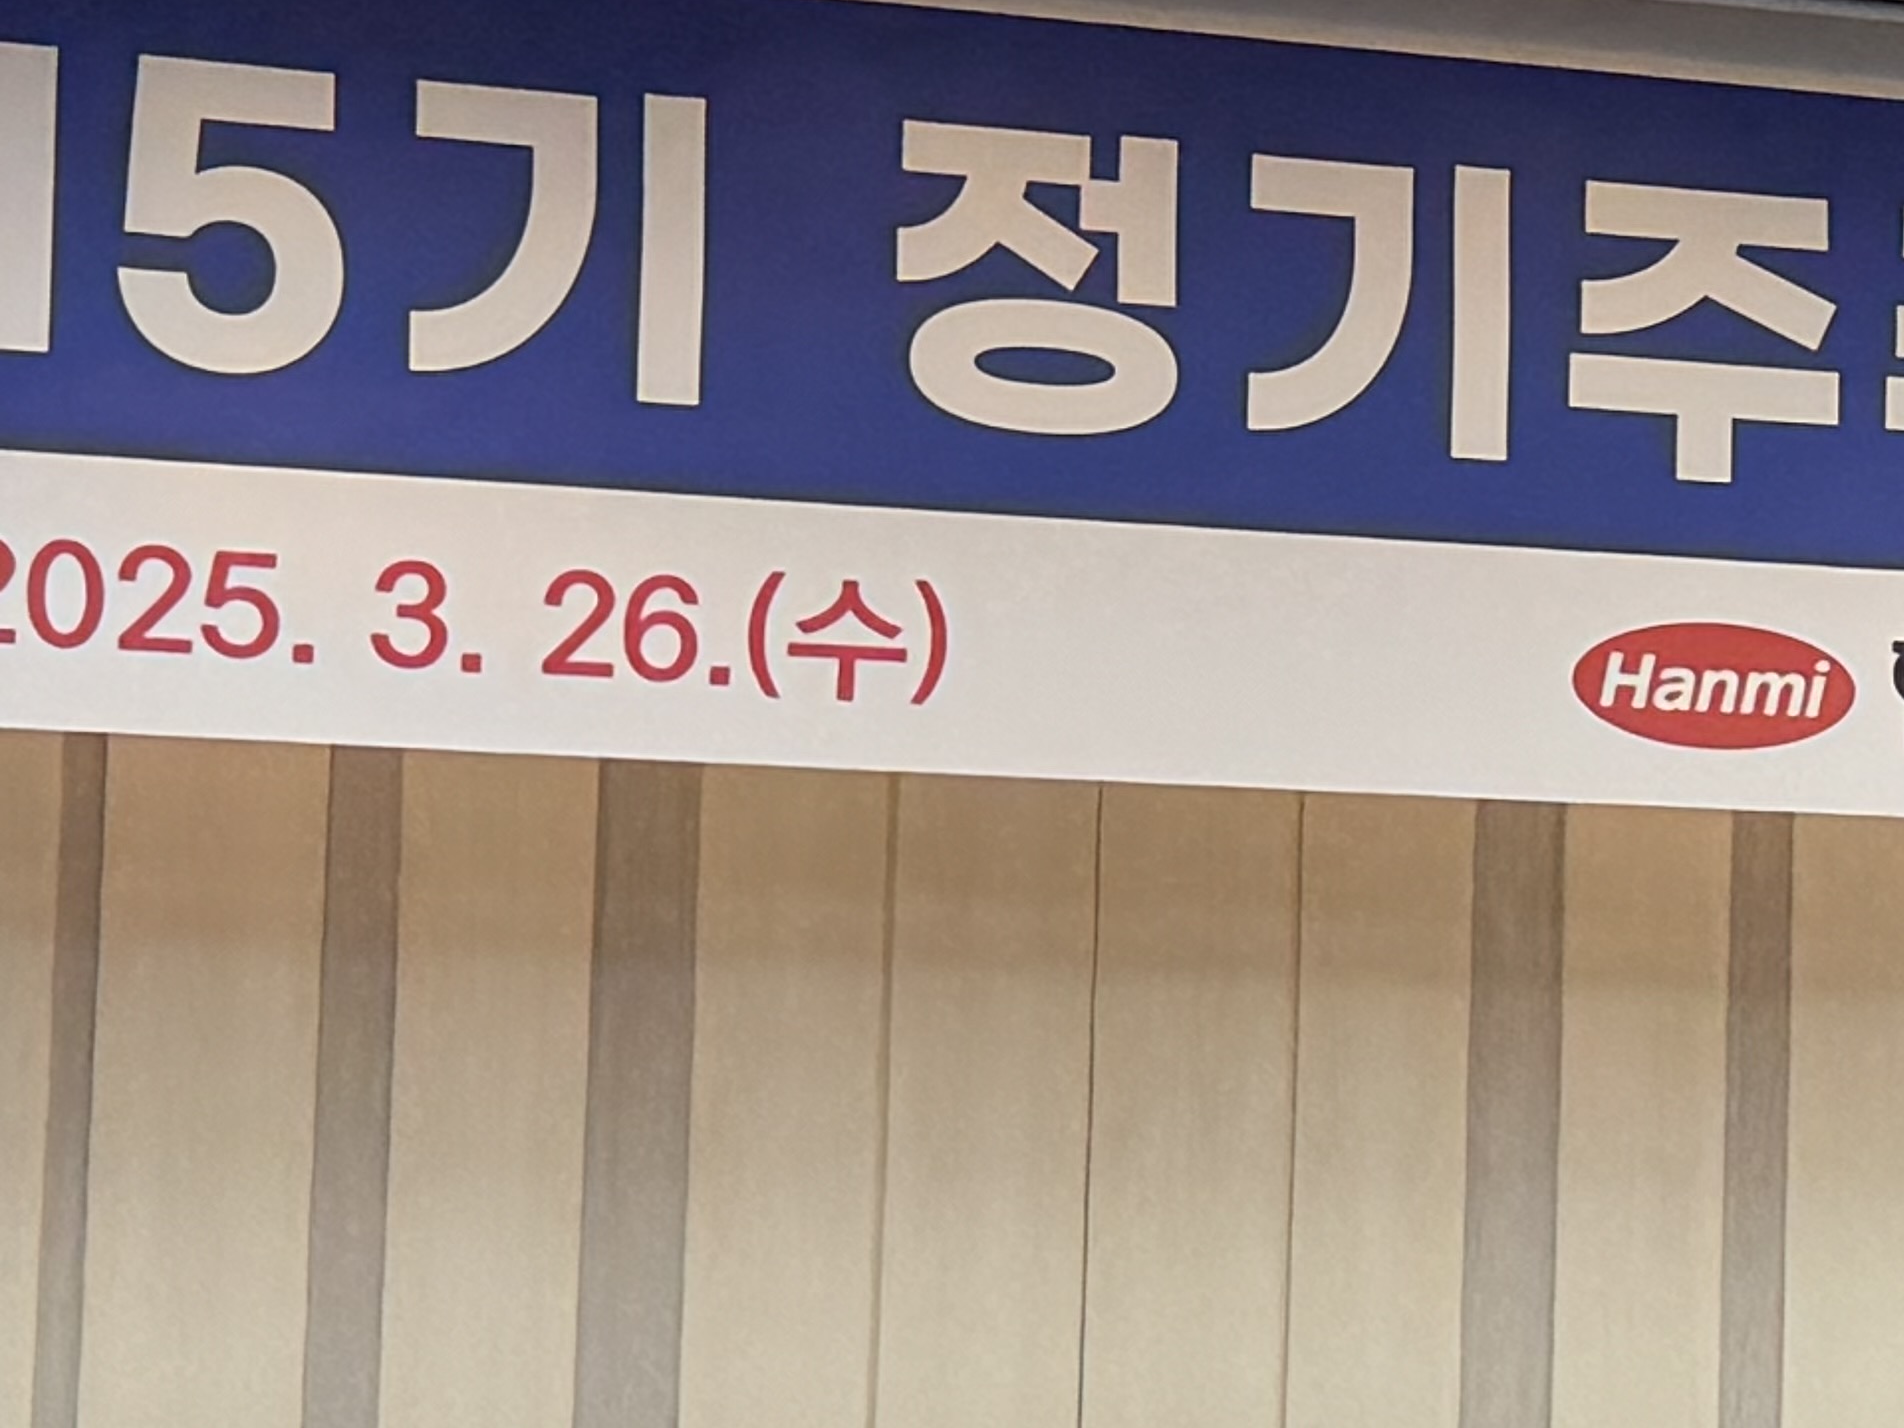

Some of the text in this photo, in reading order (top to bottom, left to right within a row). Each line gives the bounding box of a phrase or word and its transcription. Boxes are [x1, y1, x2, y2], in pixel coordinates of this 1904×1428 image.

[370, 560, 482, 674] 3.
[543, 570, 948, 705] 26.(수)
[1599, 651, 1831, 720] Hanmi
